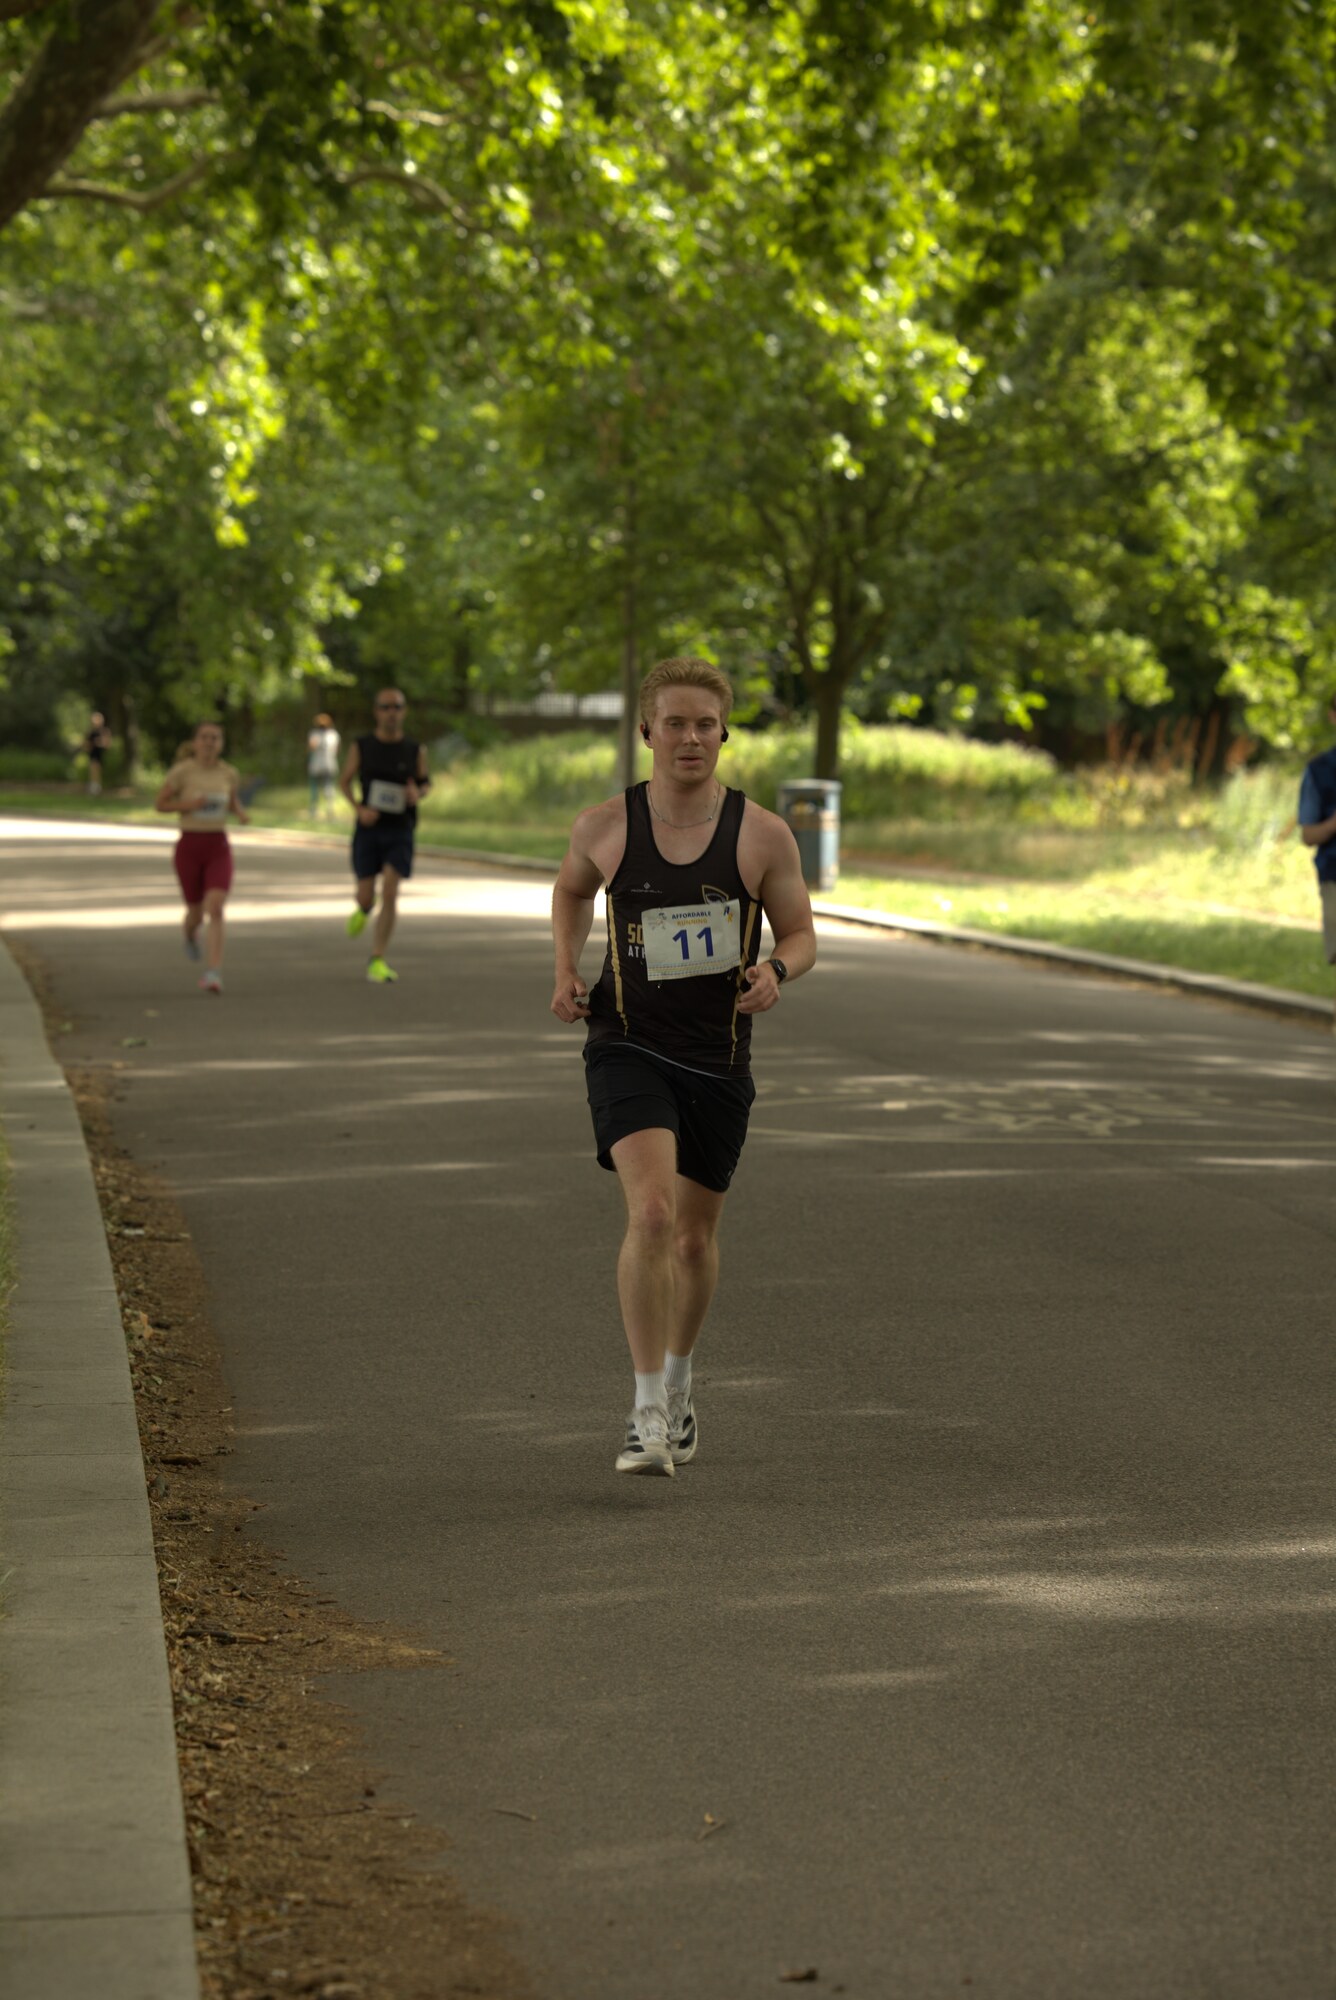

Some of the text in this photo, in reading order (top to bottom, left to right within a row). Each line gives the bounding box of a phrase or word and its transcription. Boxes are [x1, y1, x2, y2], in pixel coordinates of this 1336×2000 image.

[672, 911, 711, 920] AFFORDABLE
[677, 918, 708, 926] RUNNING
[672, 927, 714, 960] 11
